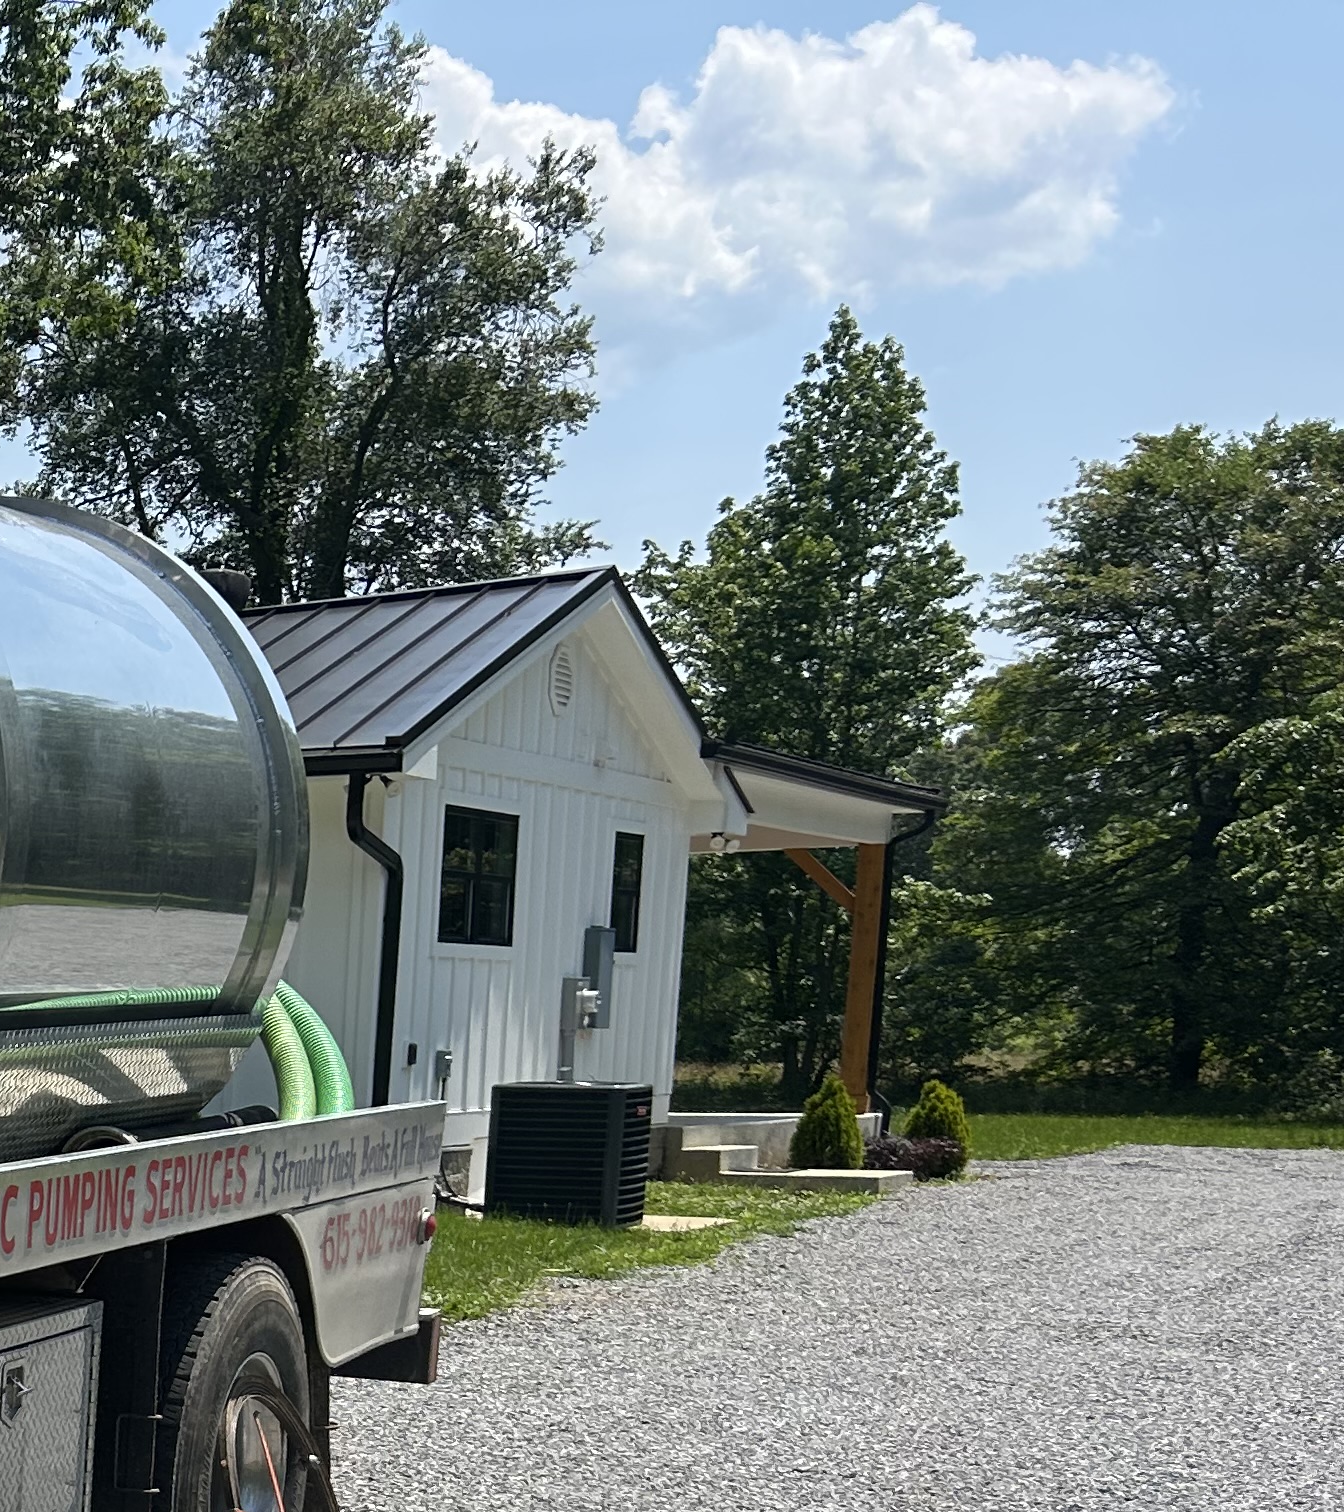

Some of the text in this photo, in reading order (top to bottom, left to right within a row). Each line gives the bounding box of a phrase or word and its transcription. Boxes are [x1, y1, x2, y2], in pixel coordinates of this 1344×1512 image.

[26, 1165, 137, 1249] PUMPING
[143, 1145, 251, 1225] SERVICES
[270, 1143, 327, 1203] Straight
